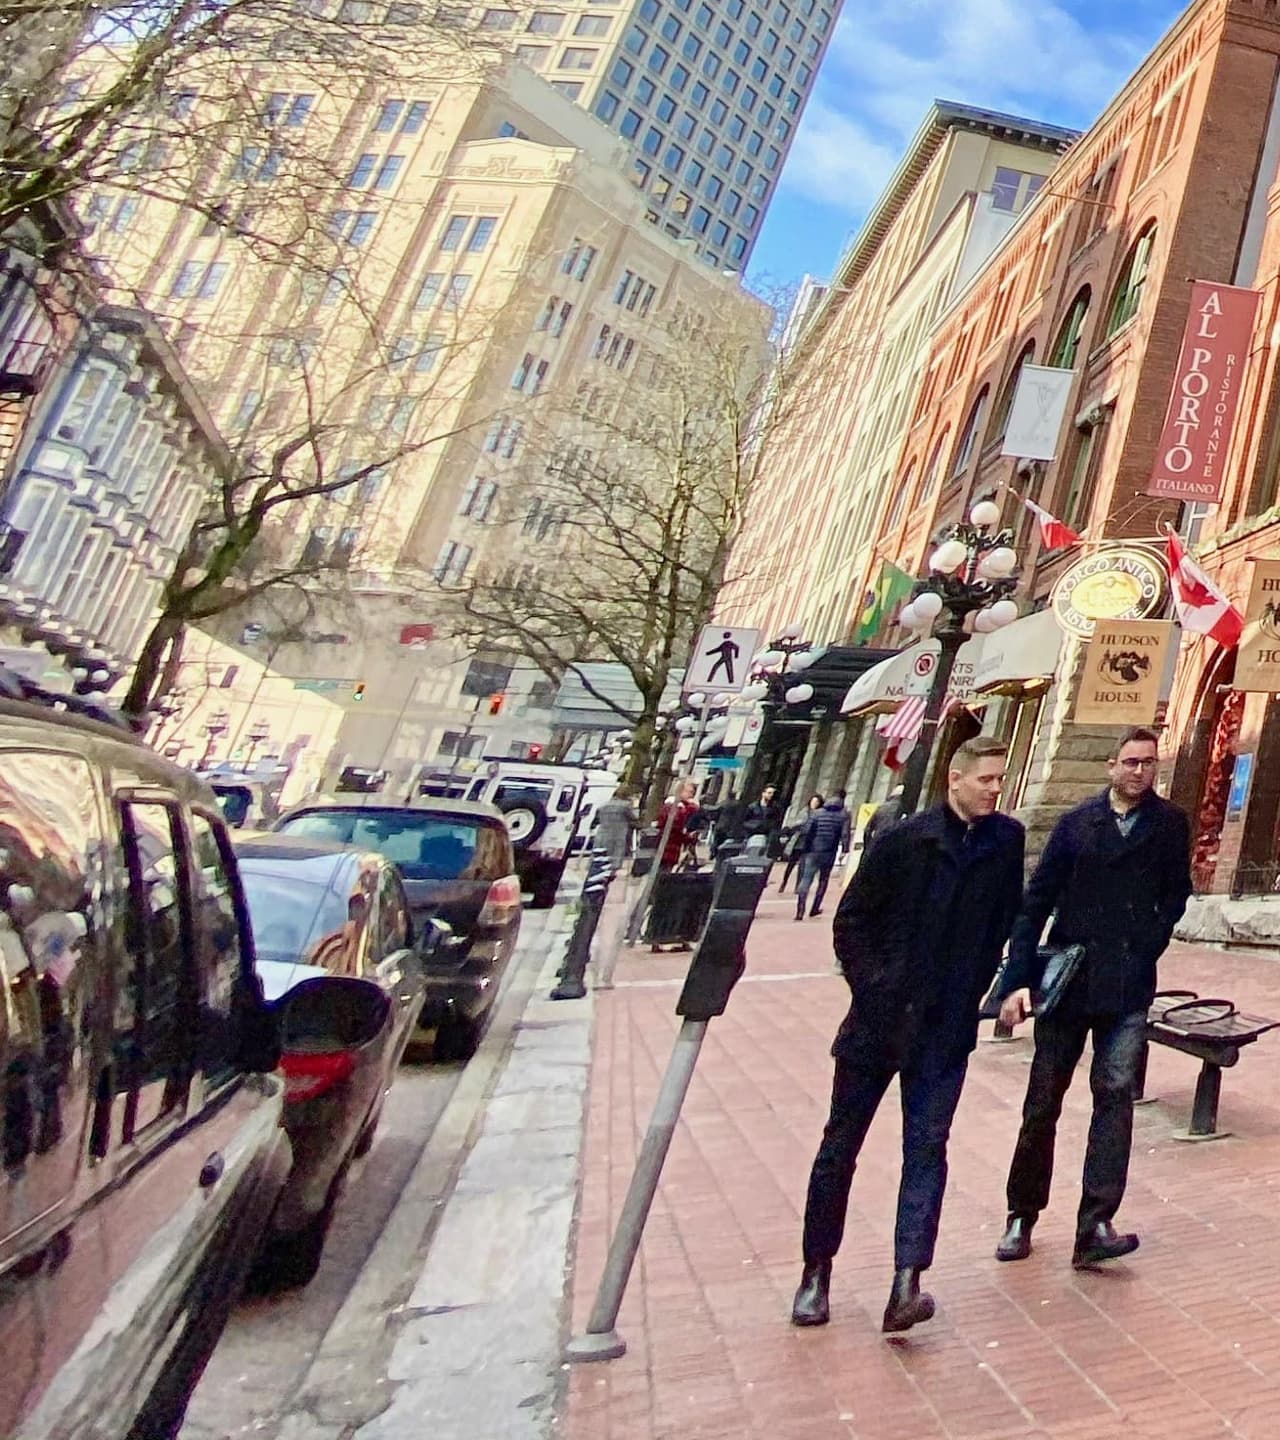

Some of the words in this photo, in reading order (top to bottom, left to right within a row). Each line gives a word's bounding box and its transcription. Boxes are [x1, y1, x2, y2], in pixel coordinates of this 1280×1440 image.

[1198, 291, 1222, 338] AL
[1164, 348, 1212, 472] PORTO
[1203, 353, 1236, 478] RISTORANTE
[1155, 478, 1216, 495] ITALIANO
[1112, 558, 1156, 599] ANTICO
[1099, 633, 1160, 646] HUDSON
[1094, 691, 1142, 703] HOUSE
